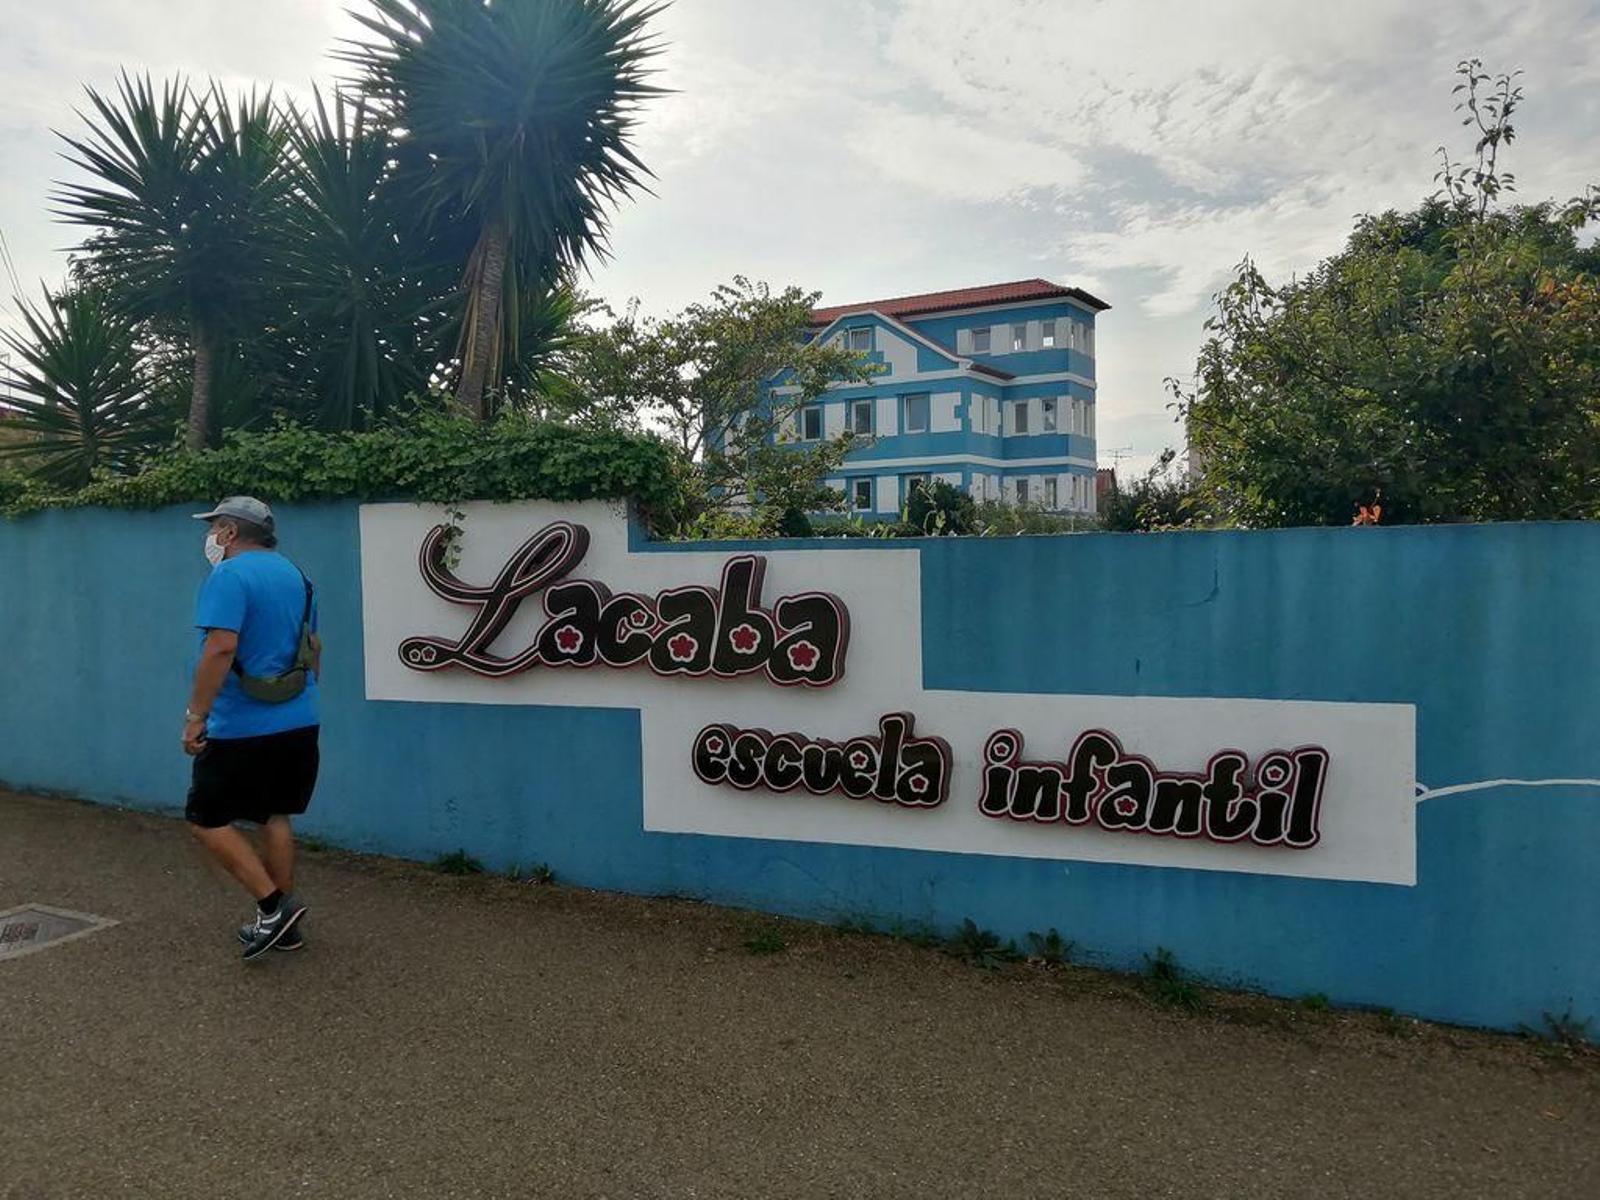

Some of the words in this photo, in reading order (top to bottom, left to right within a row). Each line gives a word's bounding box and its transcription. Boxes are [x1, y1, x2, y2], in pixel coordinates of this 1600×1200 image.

[399, 521, 849, 687] Lacaba
[692, 712, 952, 808] escuela
[979, 727, 1330, 848] infantil
